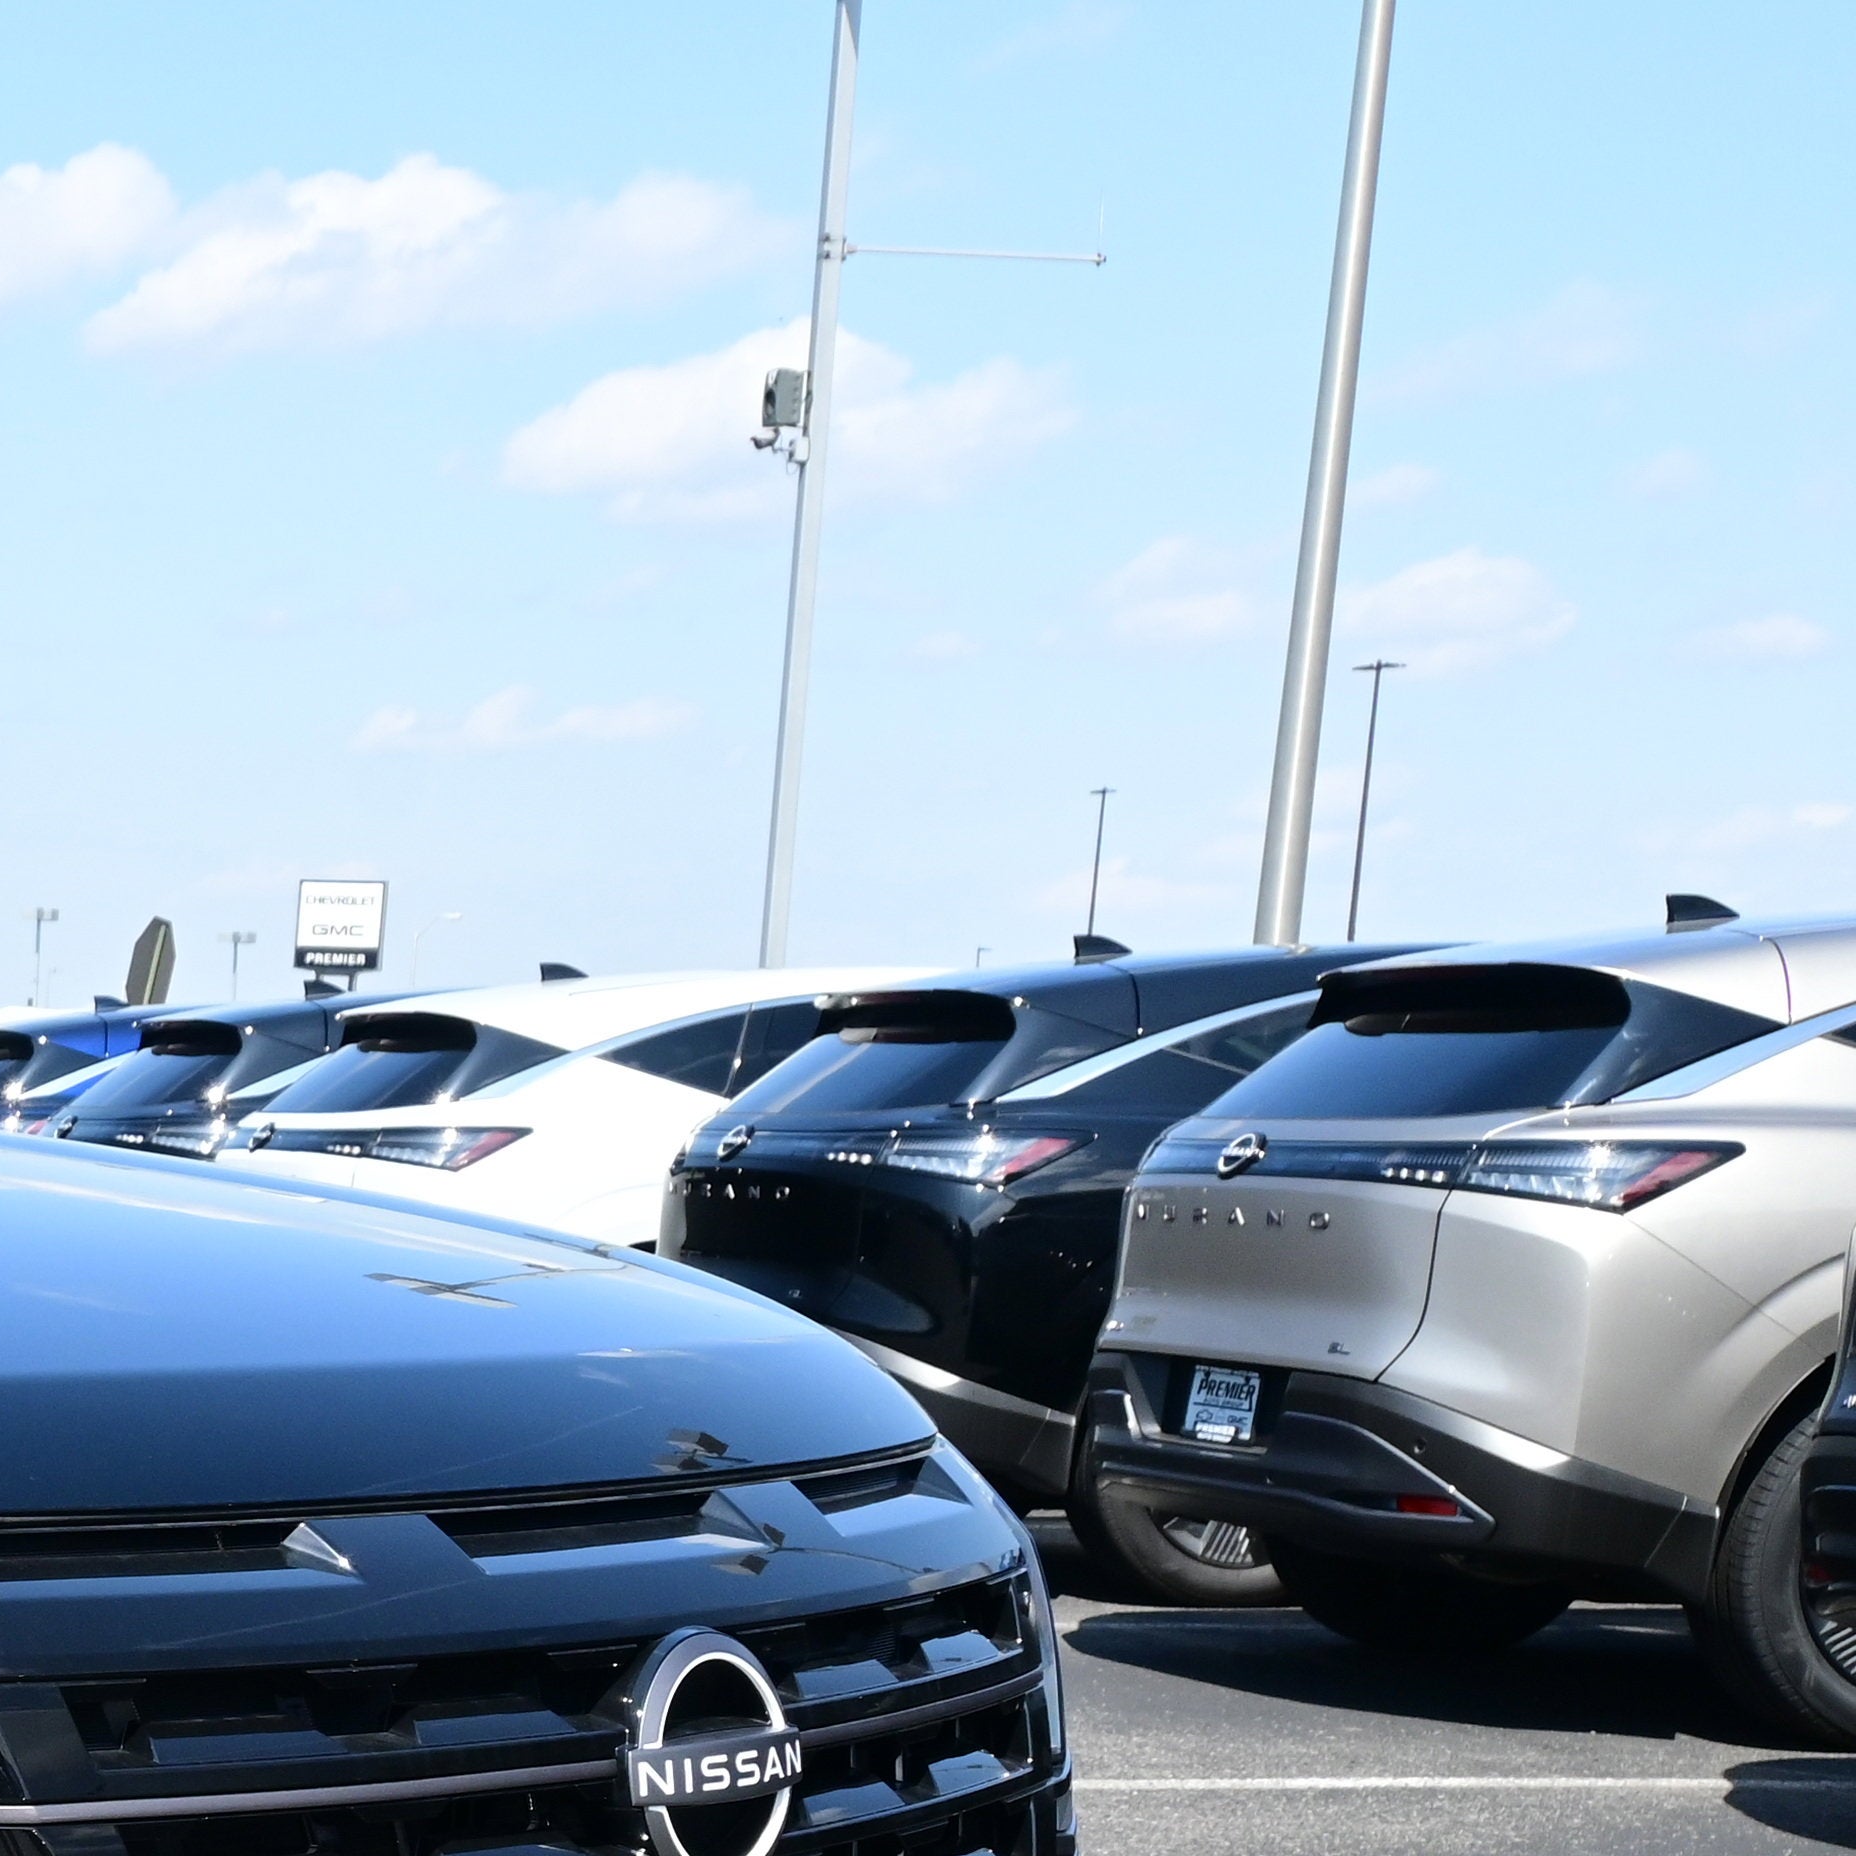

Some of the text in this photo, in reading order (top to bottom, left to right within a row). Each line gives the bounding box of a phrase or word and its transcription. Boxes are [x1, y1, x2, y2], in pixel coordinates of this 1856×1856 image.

[305, 895, 376, 906] CHEVROLET
[311, 924, 365, 937] GMC
[304, 951, 367, 966] PREMIER
[1197, 1378, 1256, 1402] PREMIER
[638, 1739, 803, 1798] NISSAN
